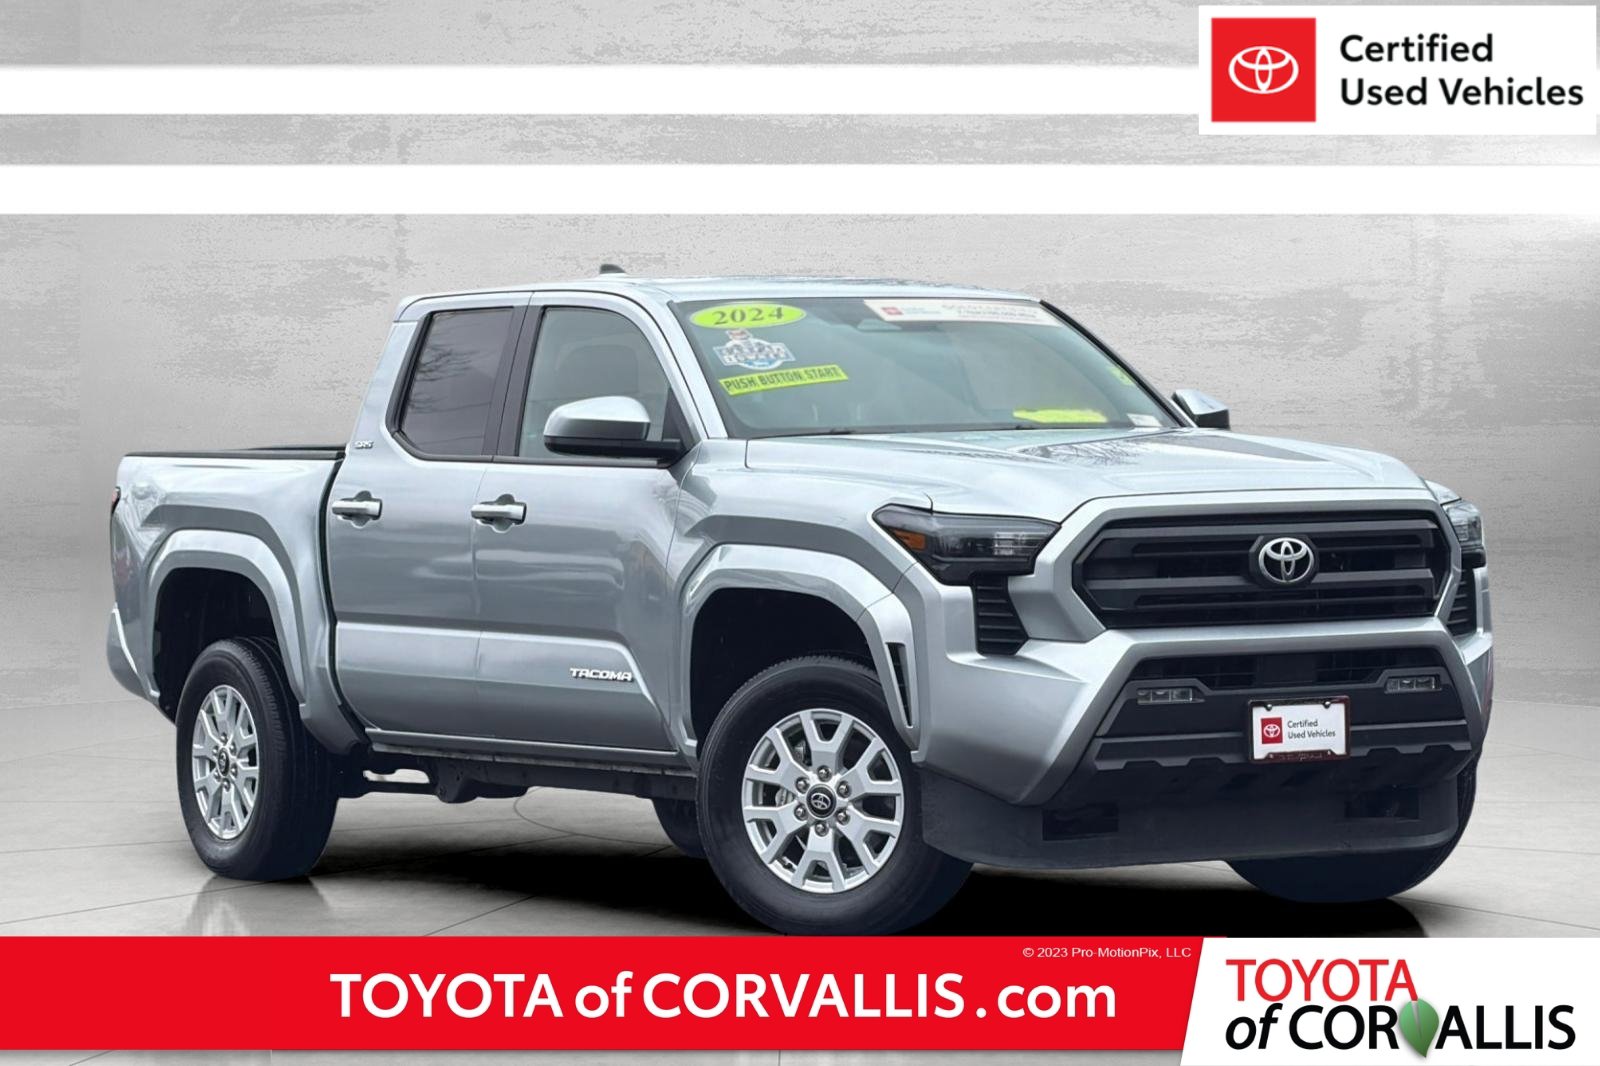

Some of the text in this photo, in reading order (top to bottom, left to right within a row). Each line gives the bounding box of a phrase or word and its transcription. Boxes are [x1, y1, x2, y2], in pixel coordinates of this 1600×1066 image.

[712, 306, 784, 325] 2024
[724, 366, 842, 391] PUSH BUTTON START
[569, 667, 633, 682] TACOMA
[1287, 719, 1319, 728] Certified
[1287, 729, 1336, 739] Used Vehicles
